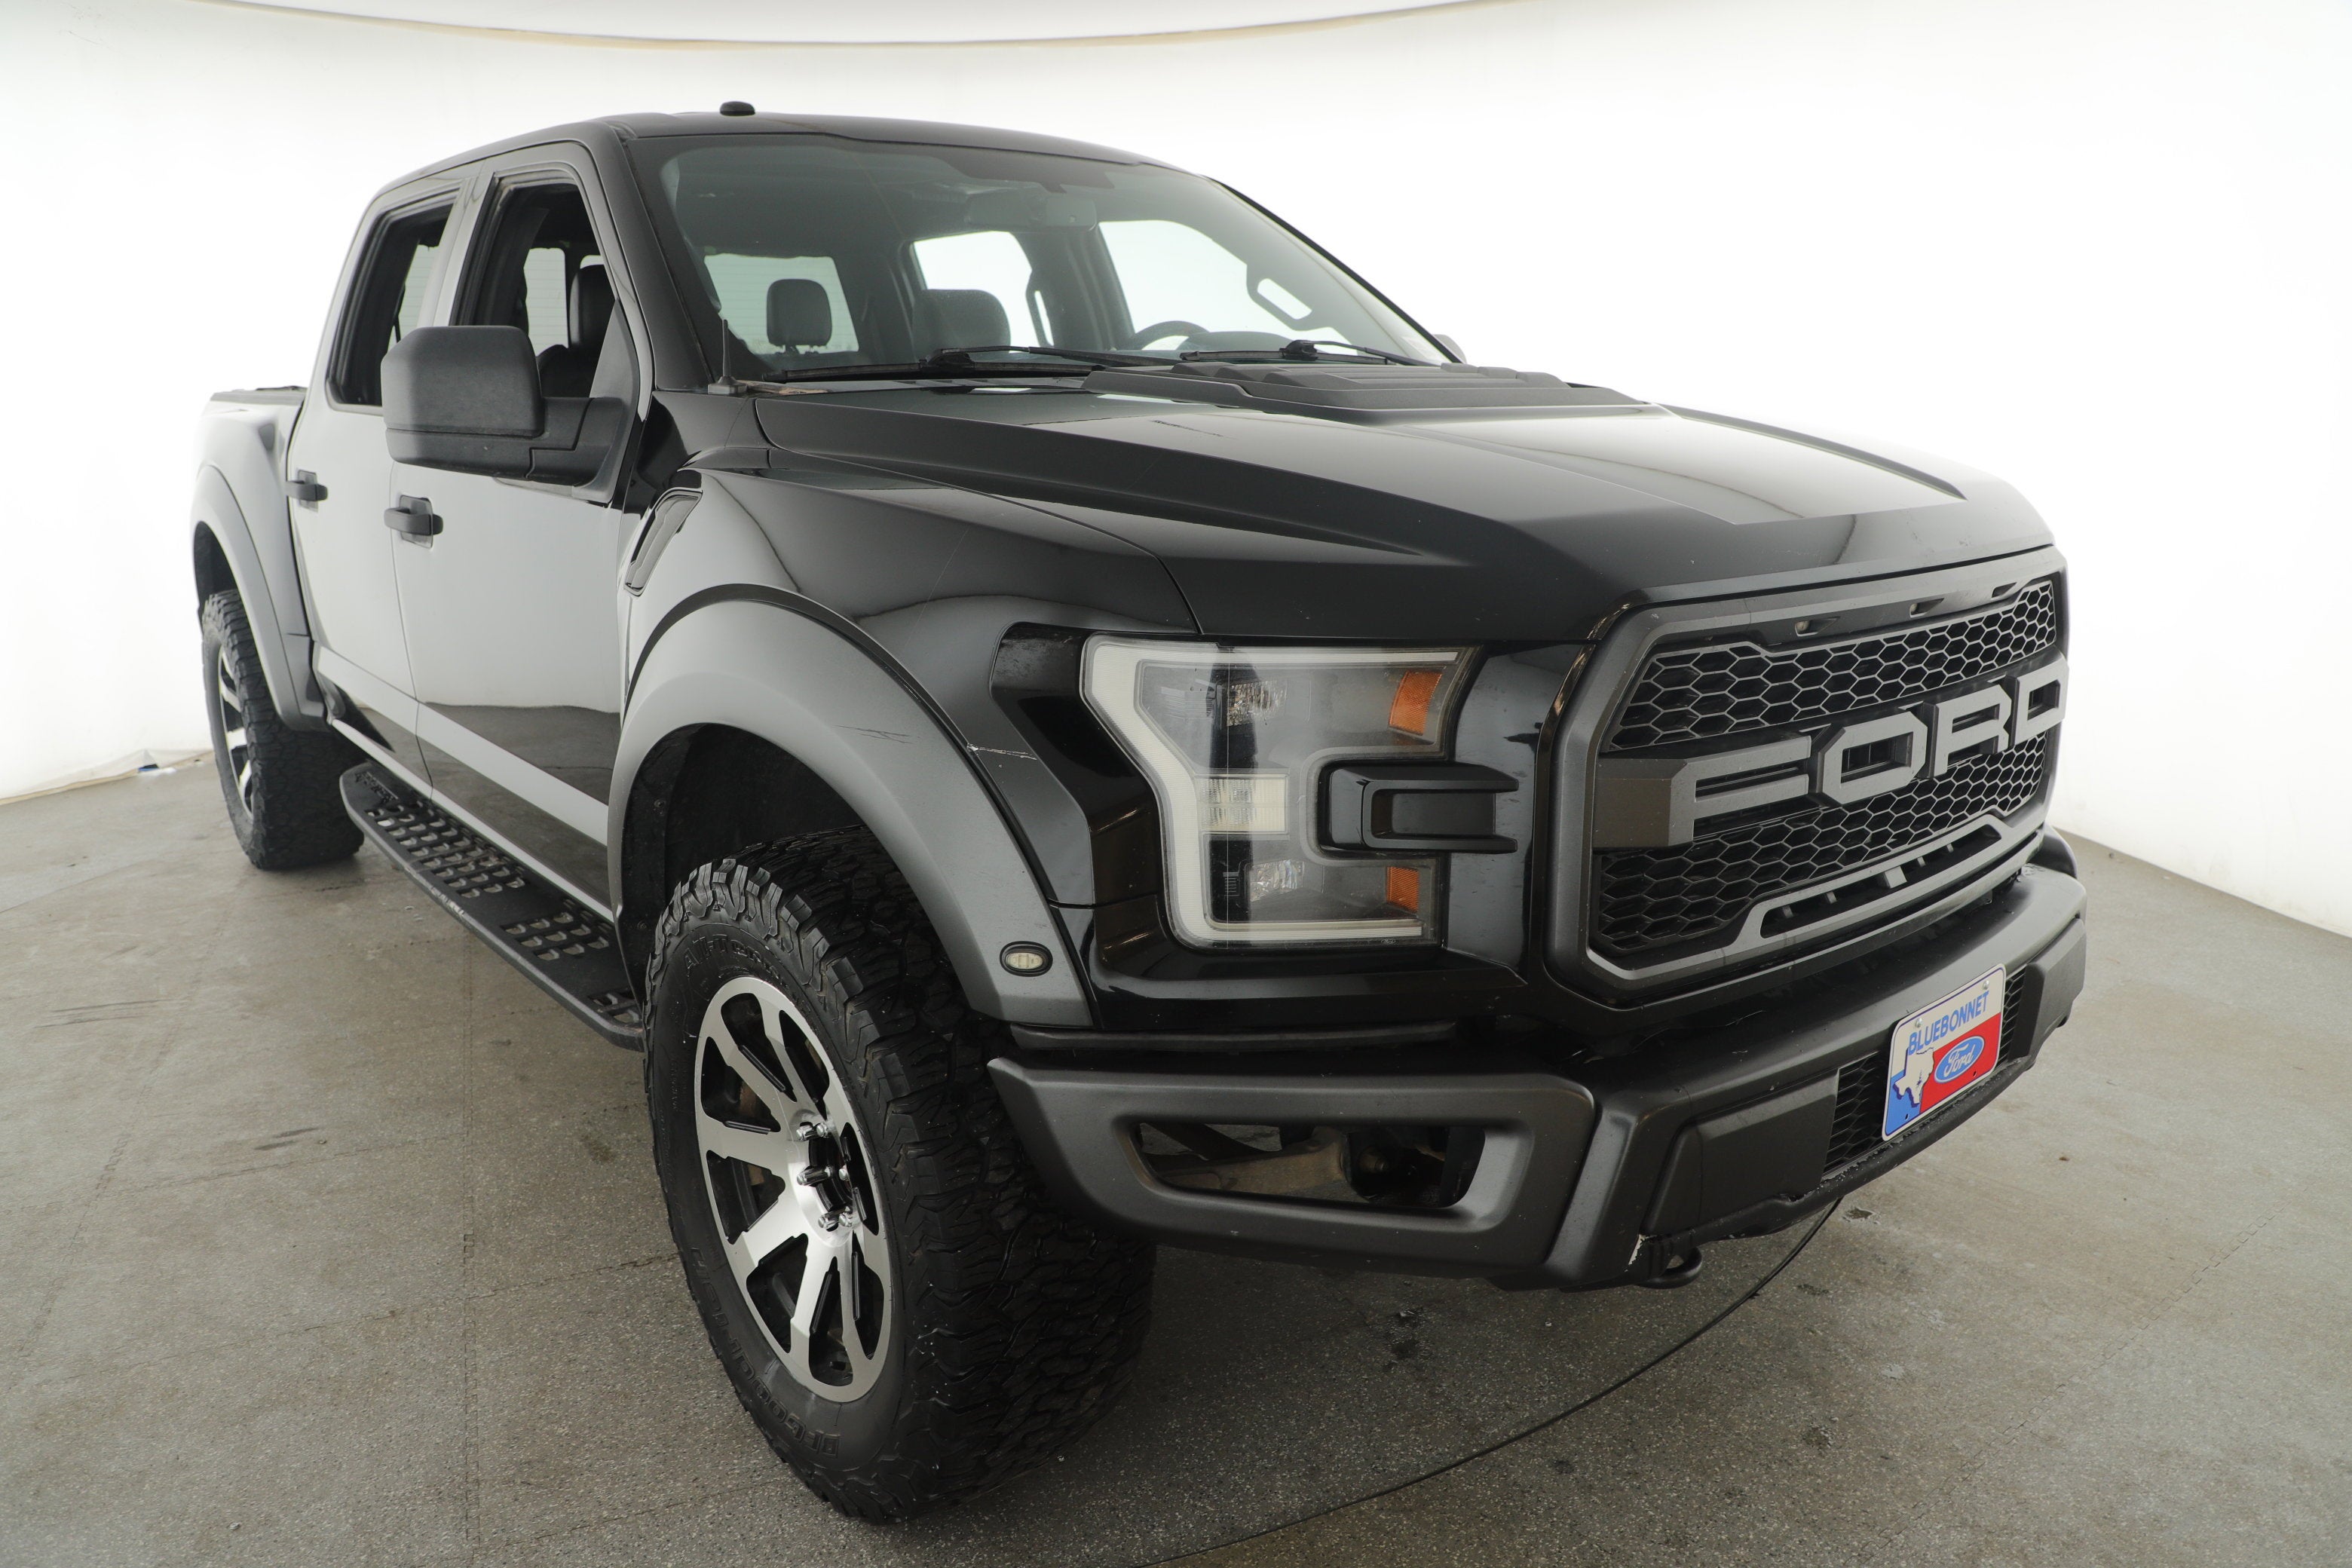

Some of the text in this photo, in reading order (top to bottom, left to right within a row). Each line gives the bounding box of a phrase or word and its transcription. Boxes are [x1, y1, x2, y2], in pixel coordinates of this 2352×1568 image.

[1668, 657, 2069, 847] FORD
[1907, 991, 1989, 1055] BLUEBONNET
[1943, 1043, 1977, 1077] Ford
